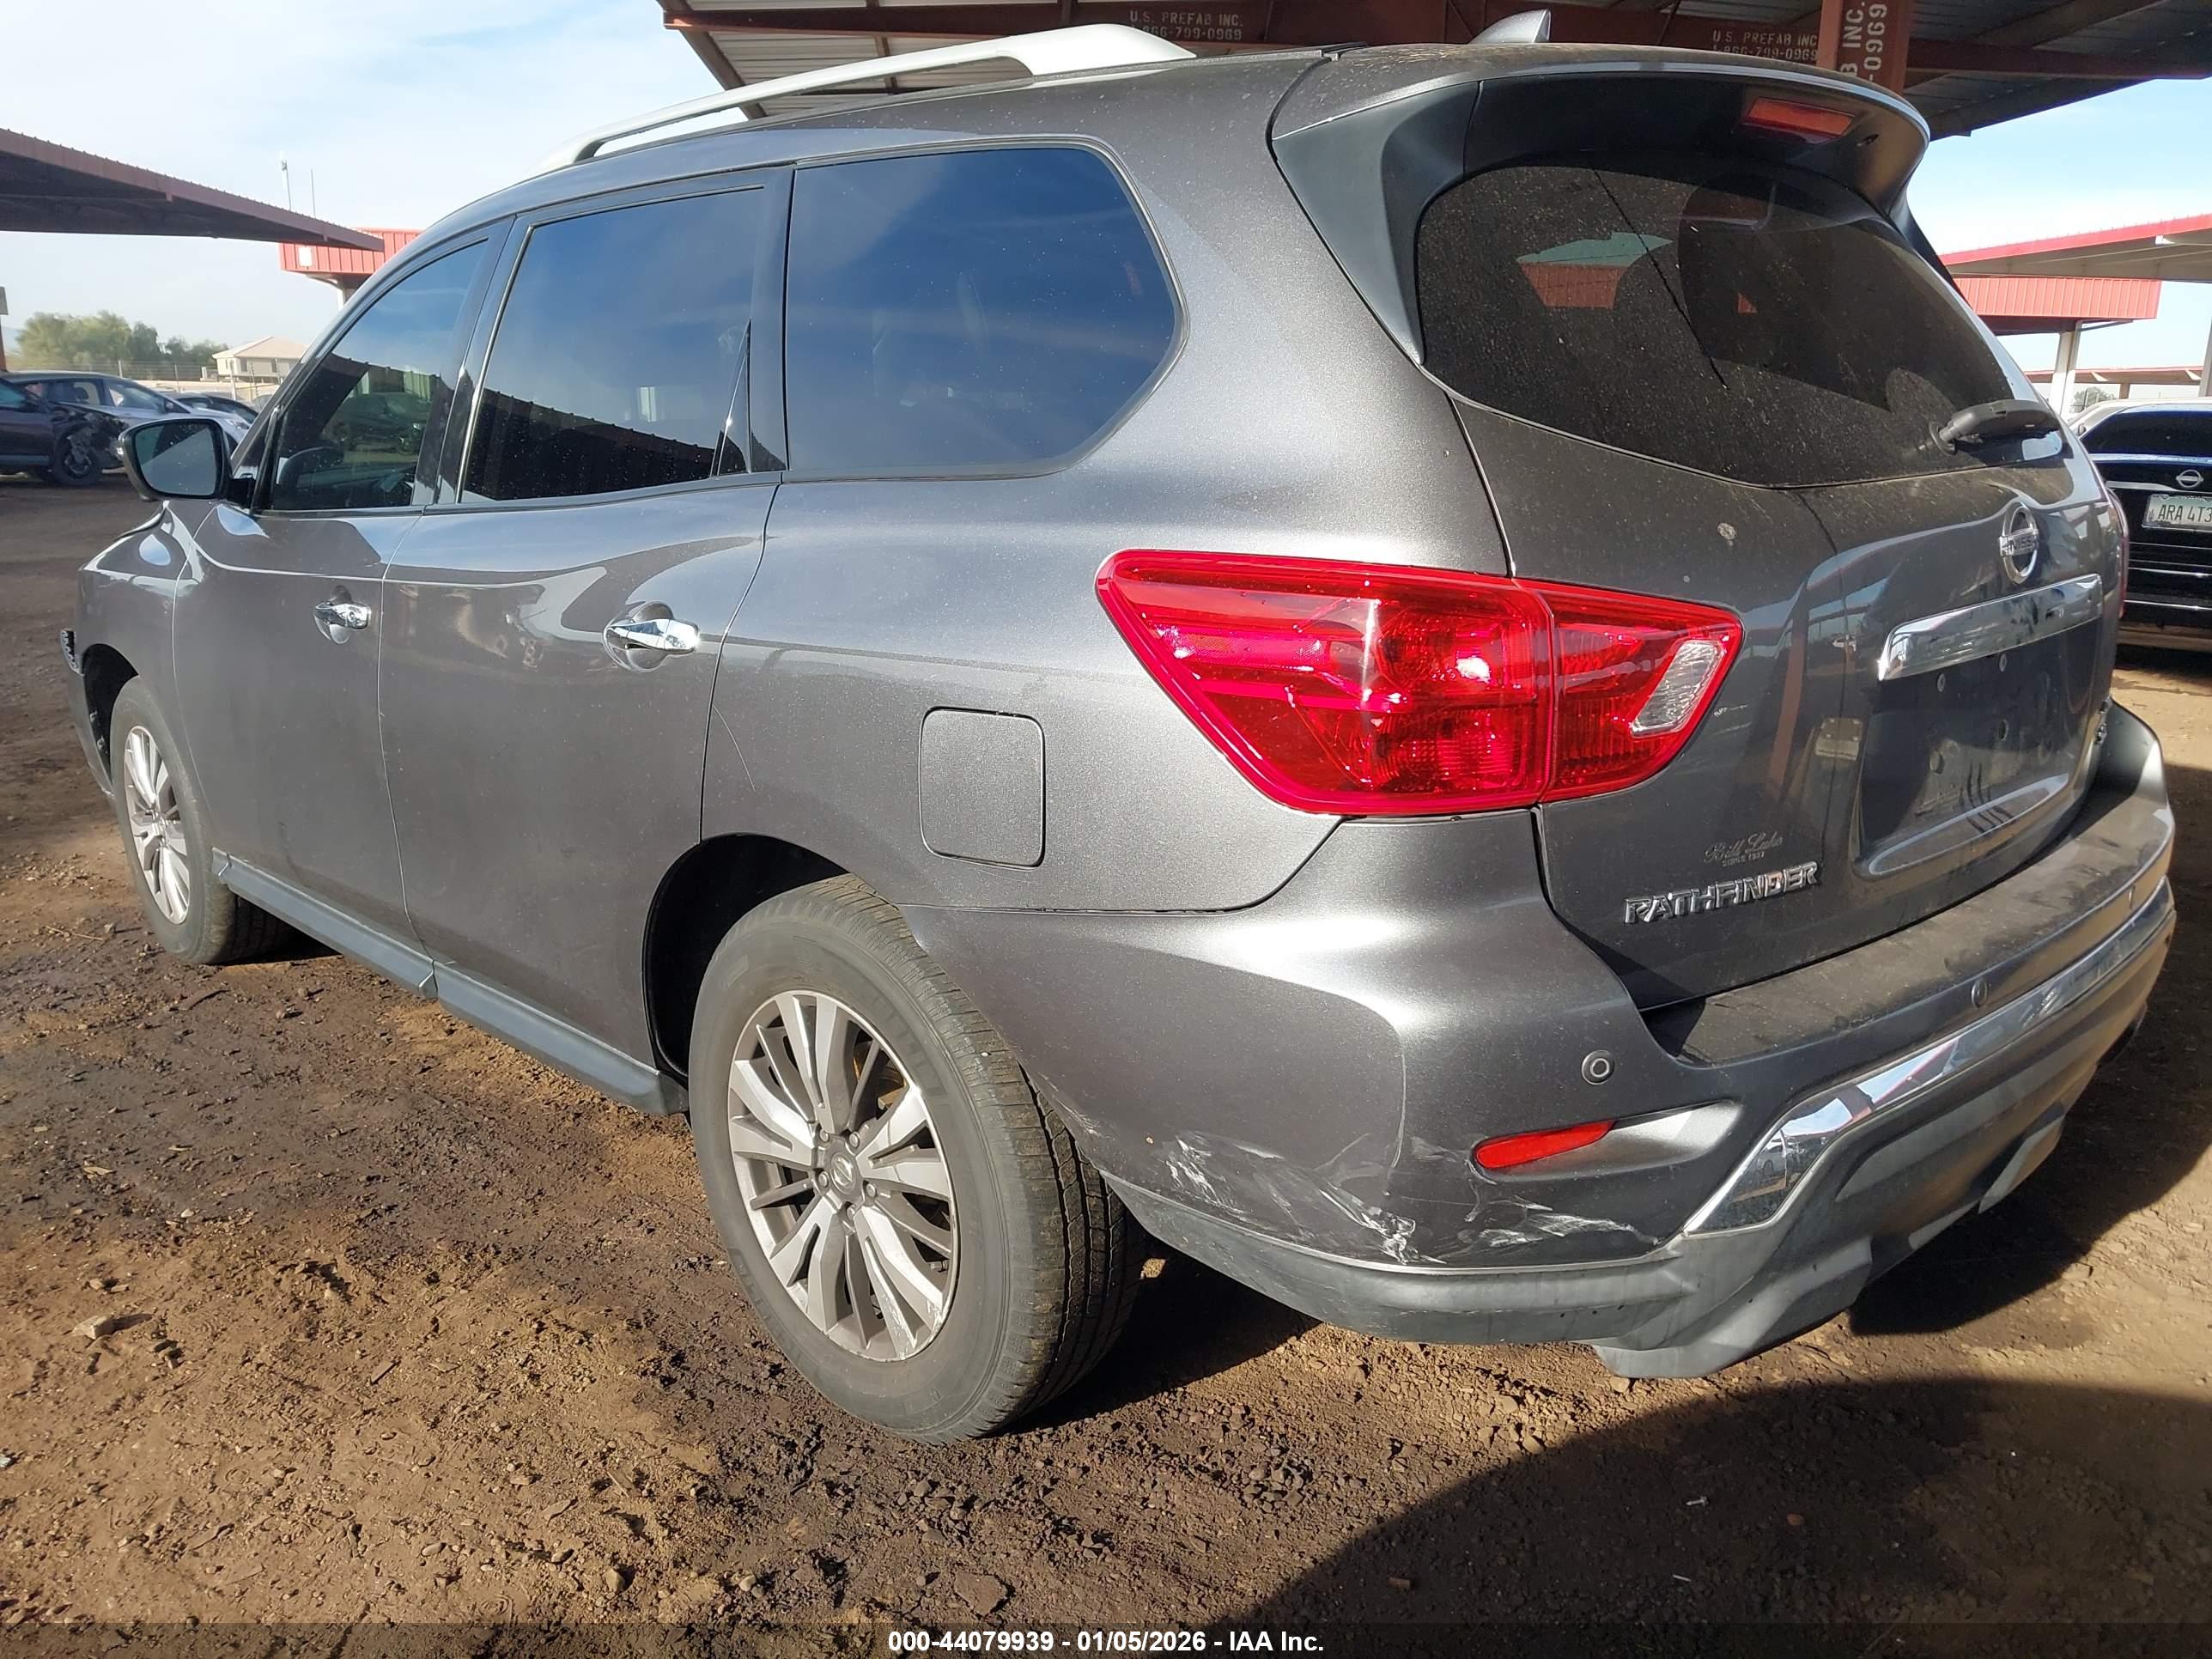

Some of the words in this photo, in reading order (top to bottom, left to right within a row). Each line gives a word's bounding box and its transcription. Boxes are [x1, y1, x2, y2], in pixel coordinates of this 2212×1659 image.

[1129, 10, 1155, 23] U.S.
[1162, 11, 1211, 25] PREFAB
[1218, 13, 1243, 27] INC.
[1843, 1, 1866, 49] INC.
[1743, 31, 1791, 46] PREFAB
[2157, 504, 2184, 521] ARA
[1623, 860, 1819, 924] PATHFINDER
